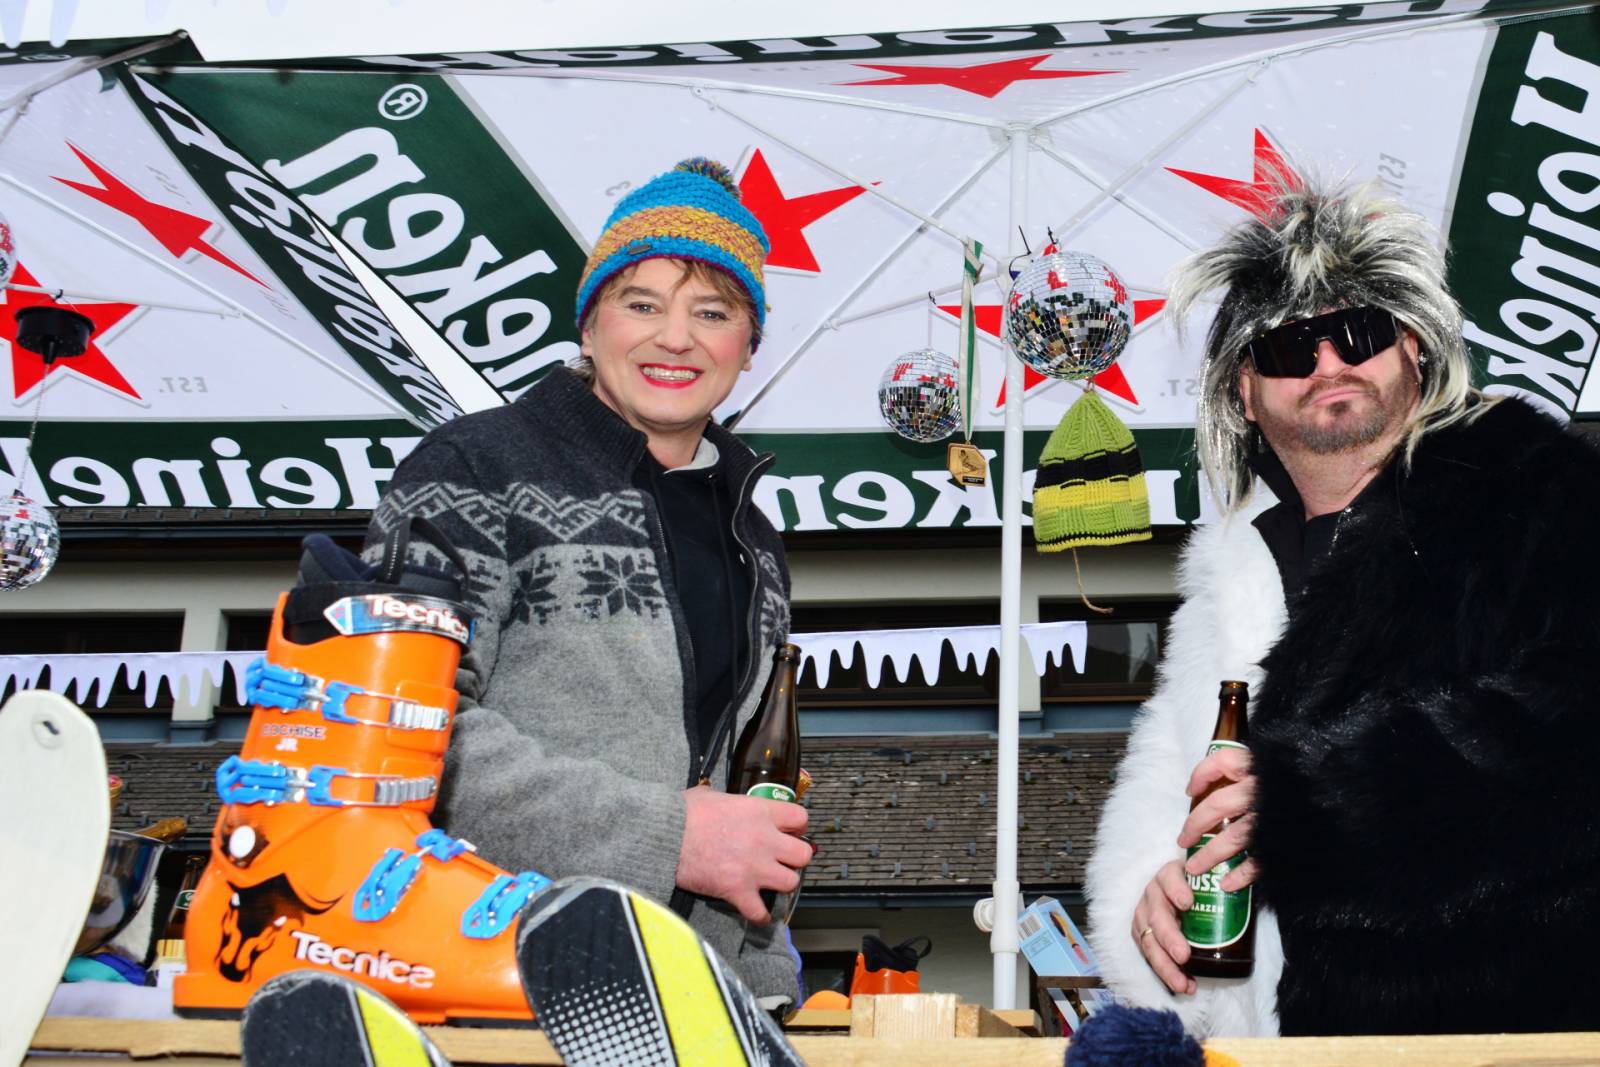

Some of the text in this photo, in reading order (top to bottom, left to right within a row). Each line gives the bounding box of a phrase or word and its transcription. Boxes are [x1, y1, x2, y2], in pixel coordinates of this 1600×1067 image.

[365, 594, 469, 641] Tecnica
[275, 738, 298, 752] JR
[290, 930, 436, 989] Tecnica
